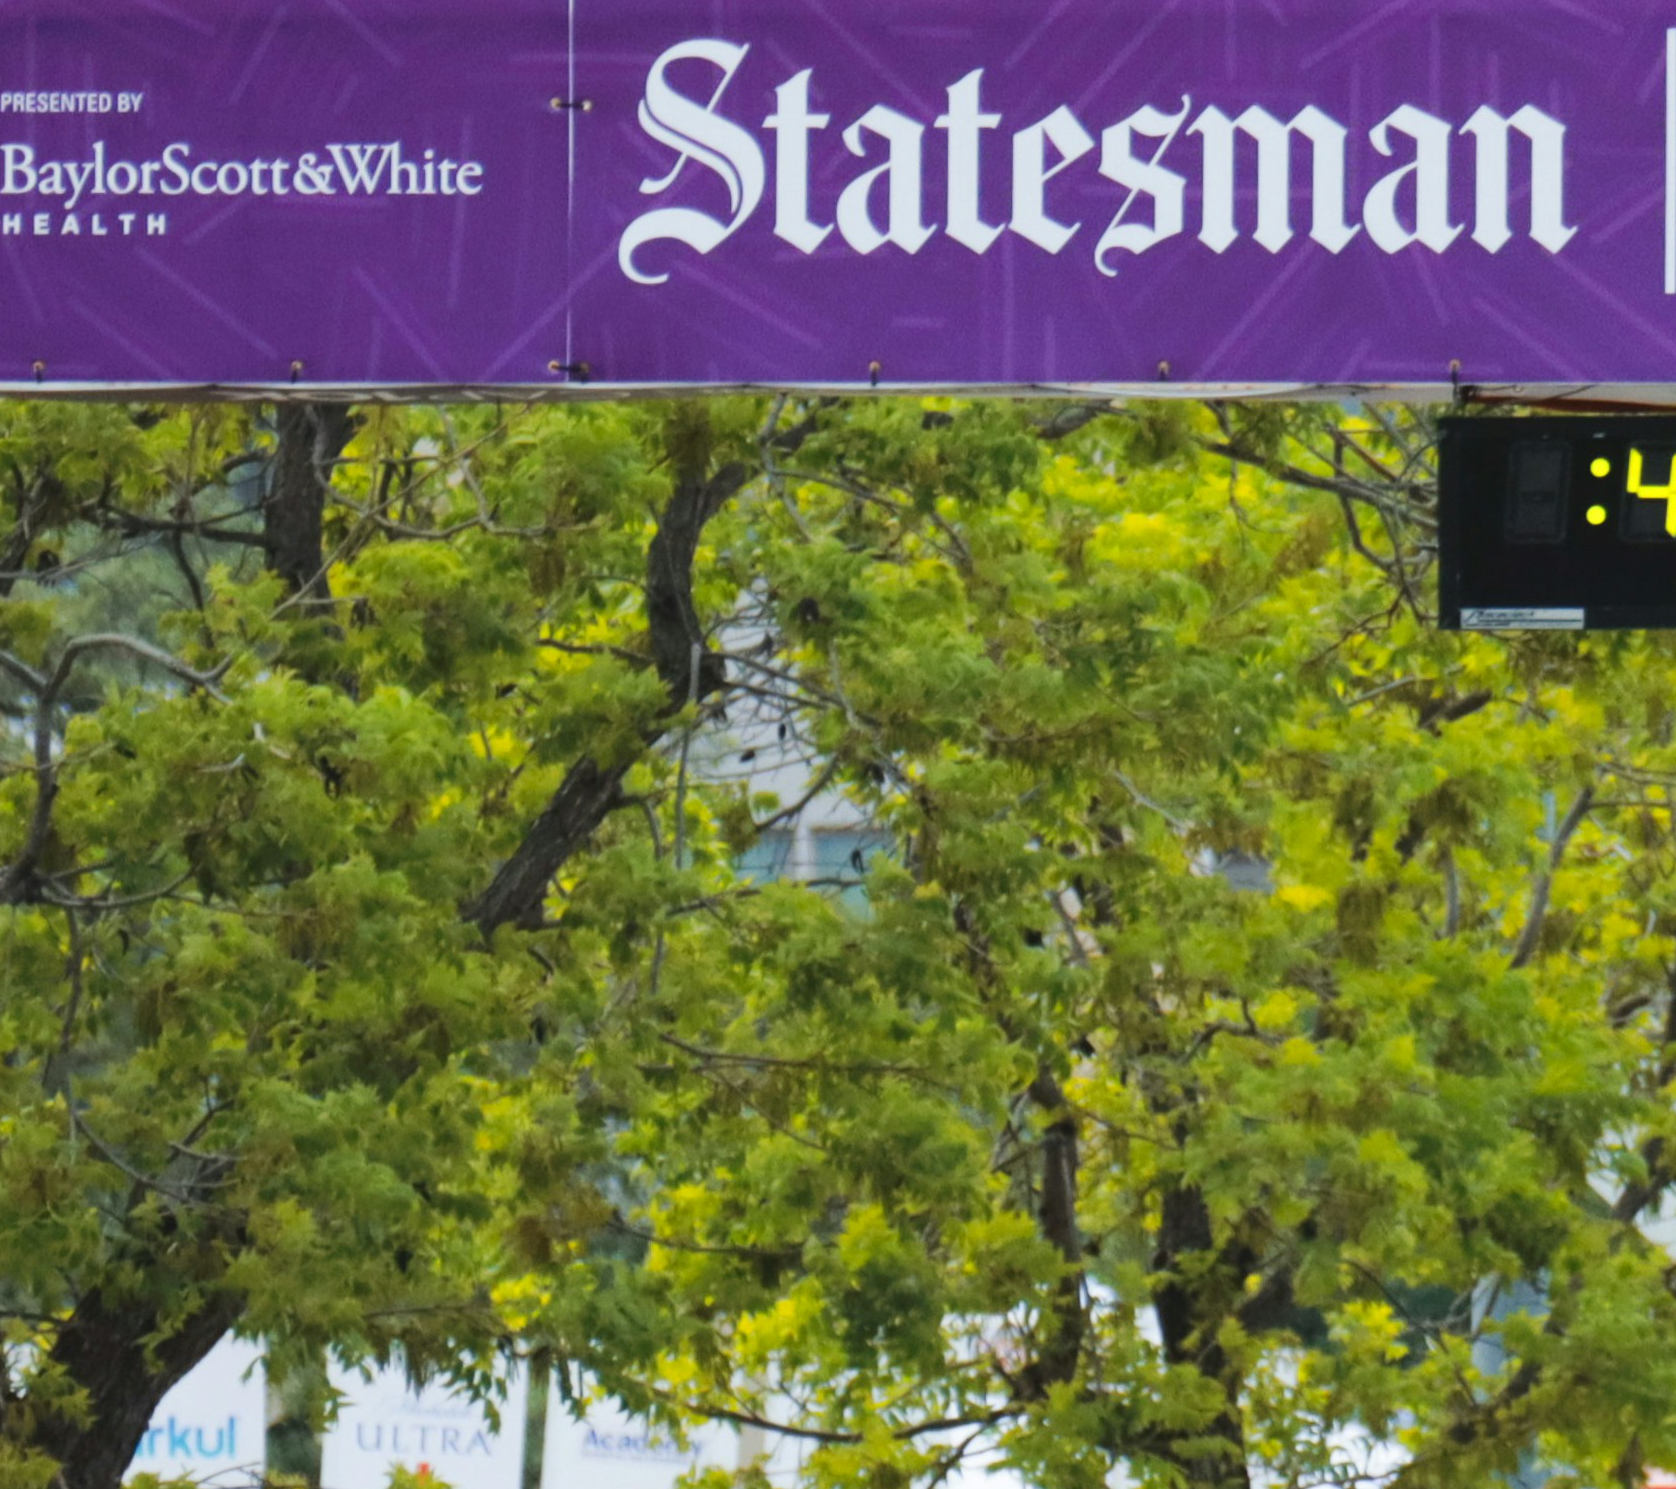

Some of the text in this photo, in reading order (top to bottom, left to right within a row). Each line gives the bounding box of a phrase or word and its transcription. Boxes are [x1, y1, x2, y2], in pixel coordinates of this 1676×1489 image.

[0, 92, 143, 113] PRESENTED BY
[0, 141, 484, 209] BaylorScott&White
[618, 38, 1578, 284] Statesman
[3, 214, 167, 235] HEALTH
[356, 1423, 493, 1457] ULTRA
